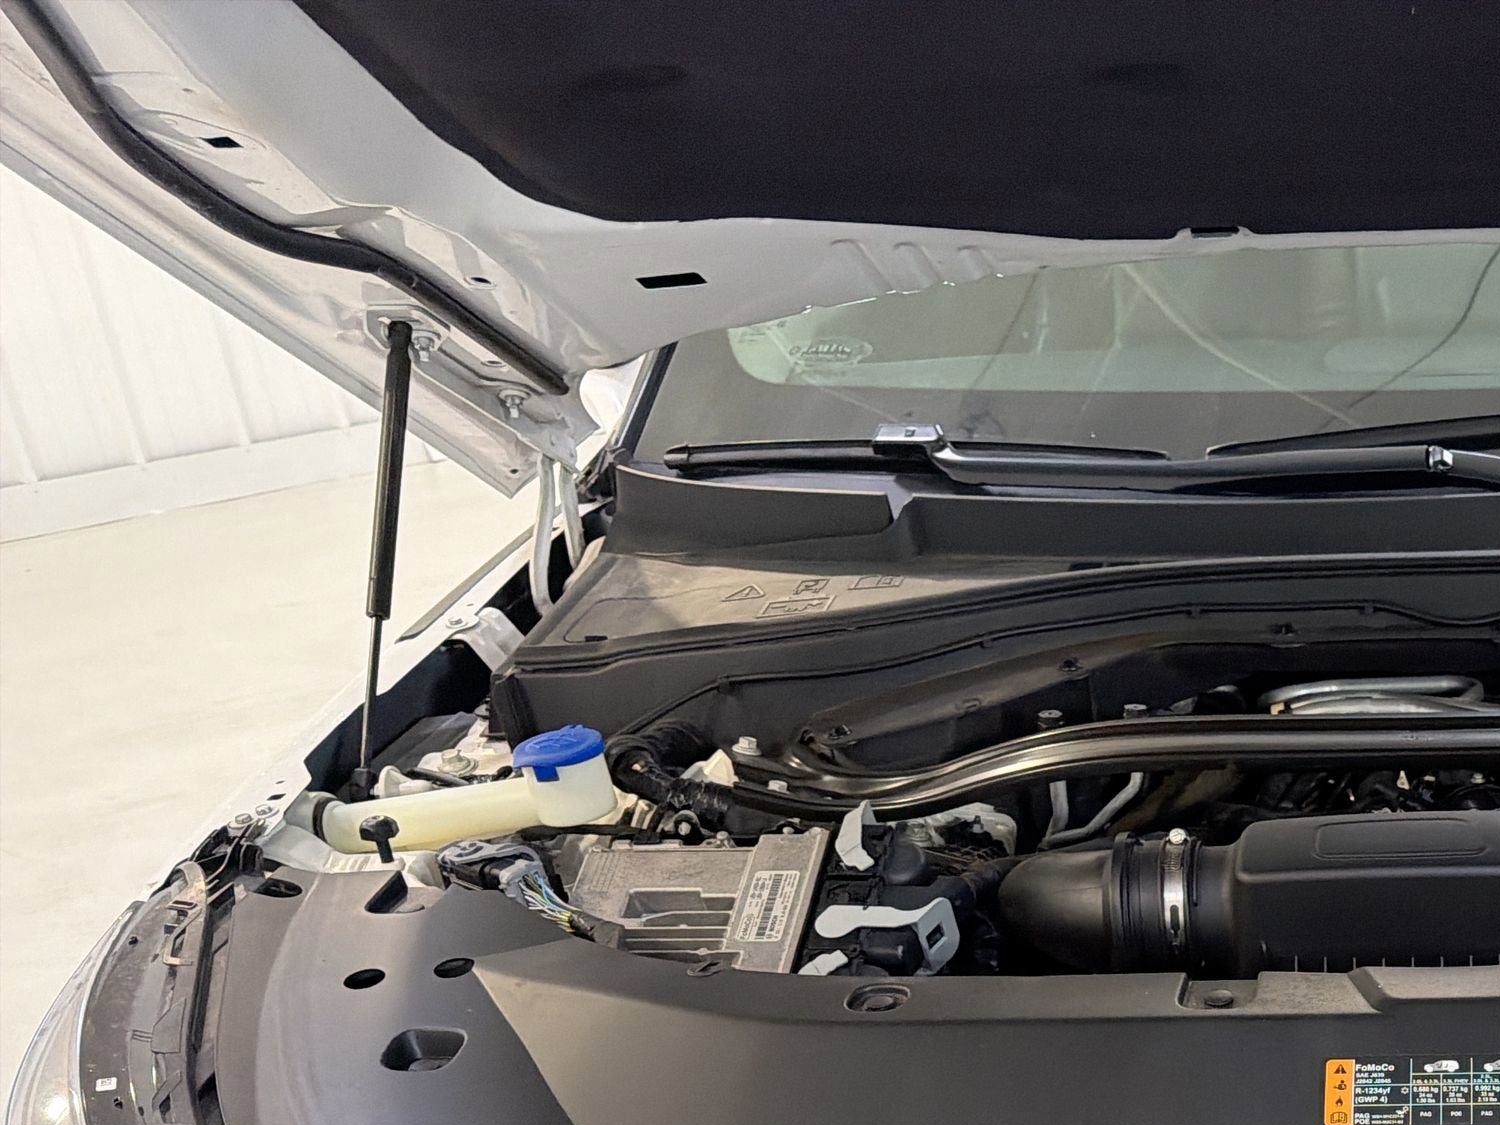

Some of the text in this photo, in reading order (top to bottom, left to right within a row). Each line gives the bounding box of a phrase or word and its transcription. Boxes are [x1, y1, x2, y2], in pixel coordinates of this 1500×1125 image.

[1355, 1063, 1395, 1071] FoMoCo
[1355, 1086, 1391, 1095] R-1234yf
[1354, 1095, 1388, 1104] (GWP 4)
